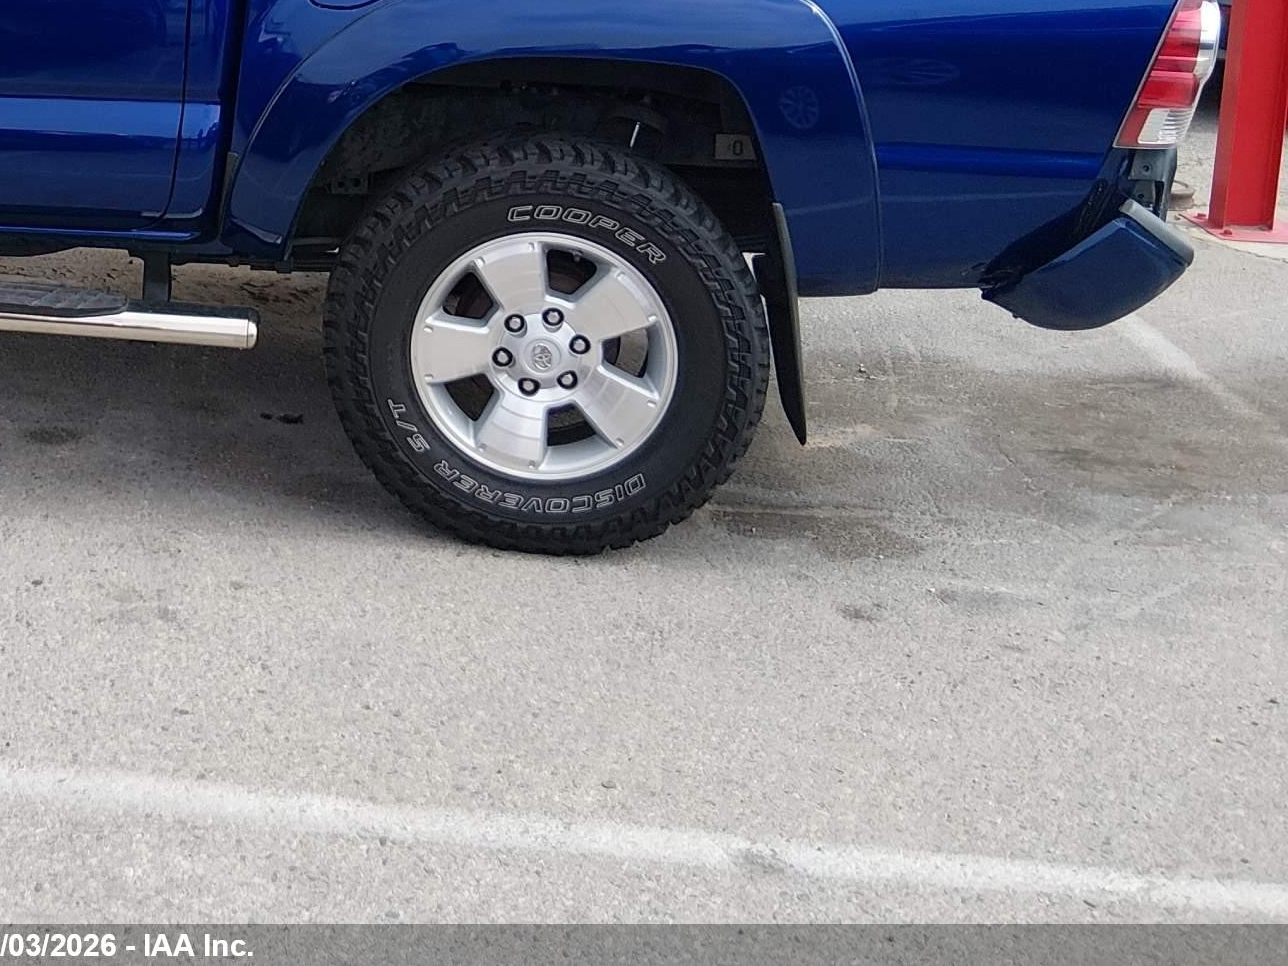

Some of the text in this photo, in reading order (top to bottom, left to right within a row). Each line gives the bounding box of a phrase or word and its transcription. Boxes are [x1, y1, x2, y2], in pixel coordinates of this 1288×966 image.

[507, 204, 667, 265] COOPER
[386, 398, 647, 514] DISCOVERER S/T
